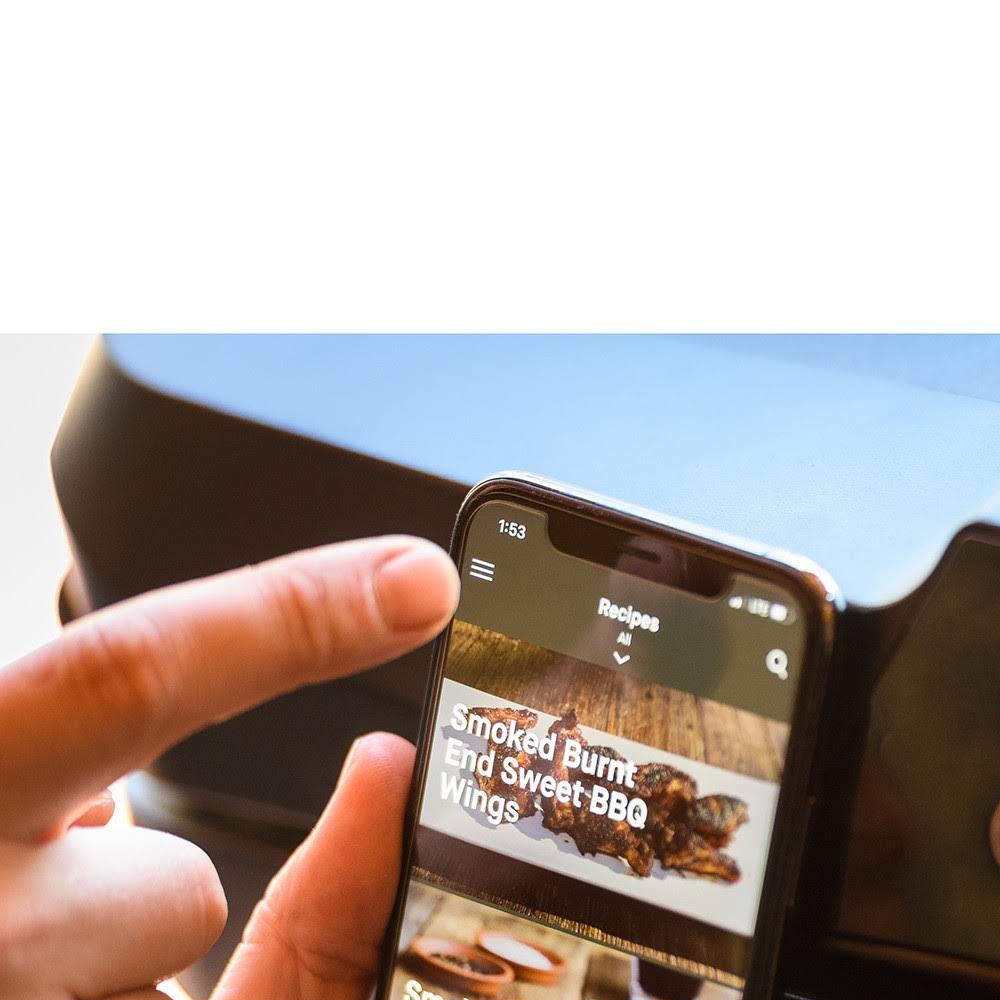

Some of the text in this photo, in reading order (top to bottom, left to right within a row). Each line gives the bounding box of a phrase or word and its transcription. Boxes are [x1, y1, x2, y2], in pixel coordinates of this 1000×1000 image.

[498, 519, 527, 540] 1:53
[597, 596, 660, 633] Recipes
[617, 632, 632, 647] All
[450, 703, 638, 789] Smoked Burnt
[440, 771, 520, 826] Wings
[445, 738, 648, 831] End Sweet BBQ
